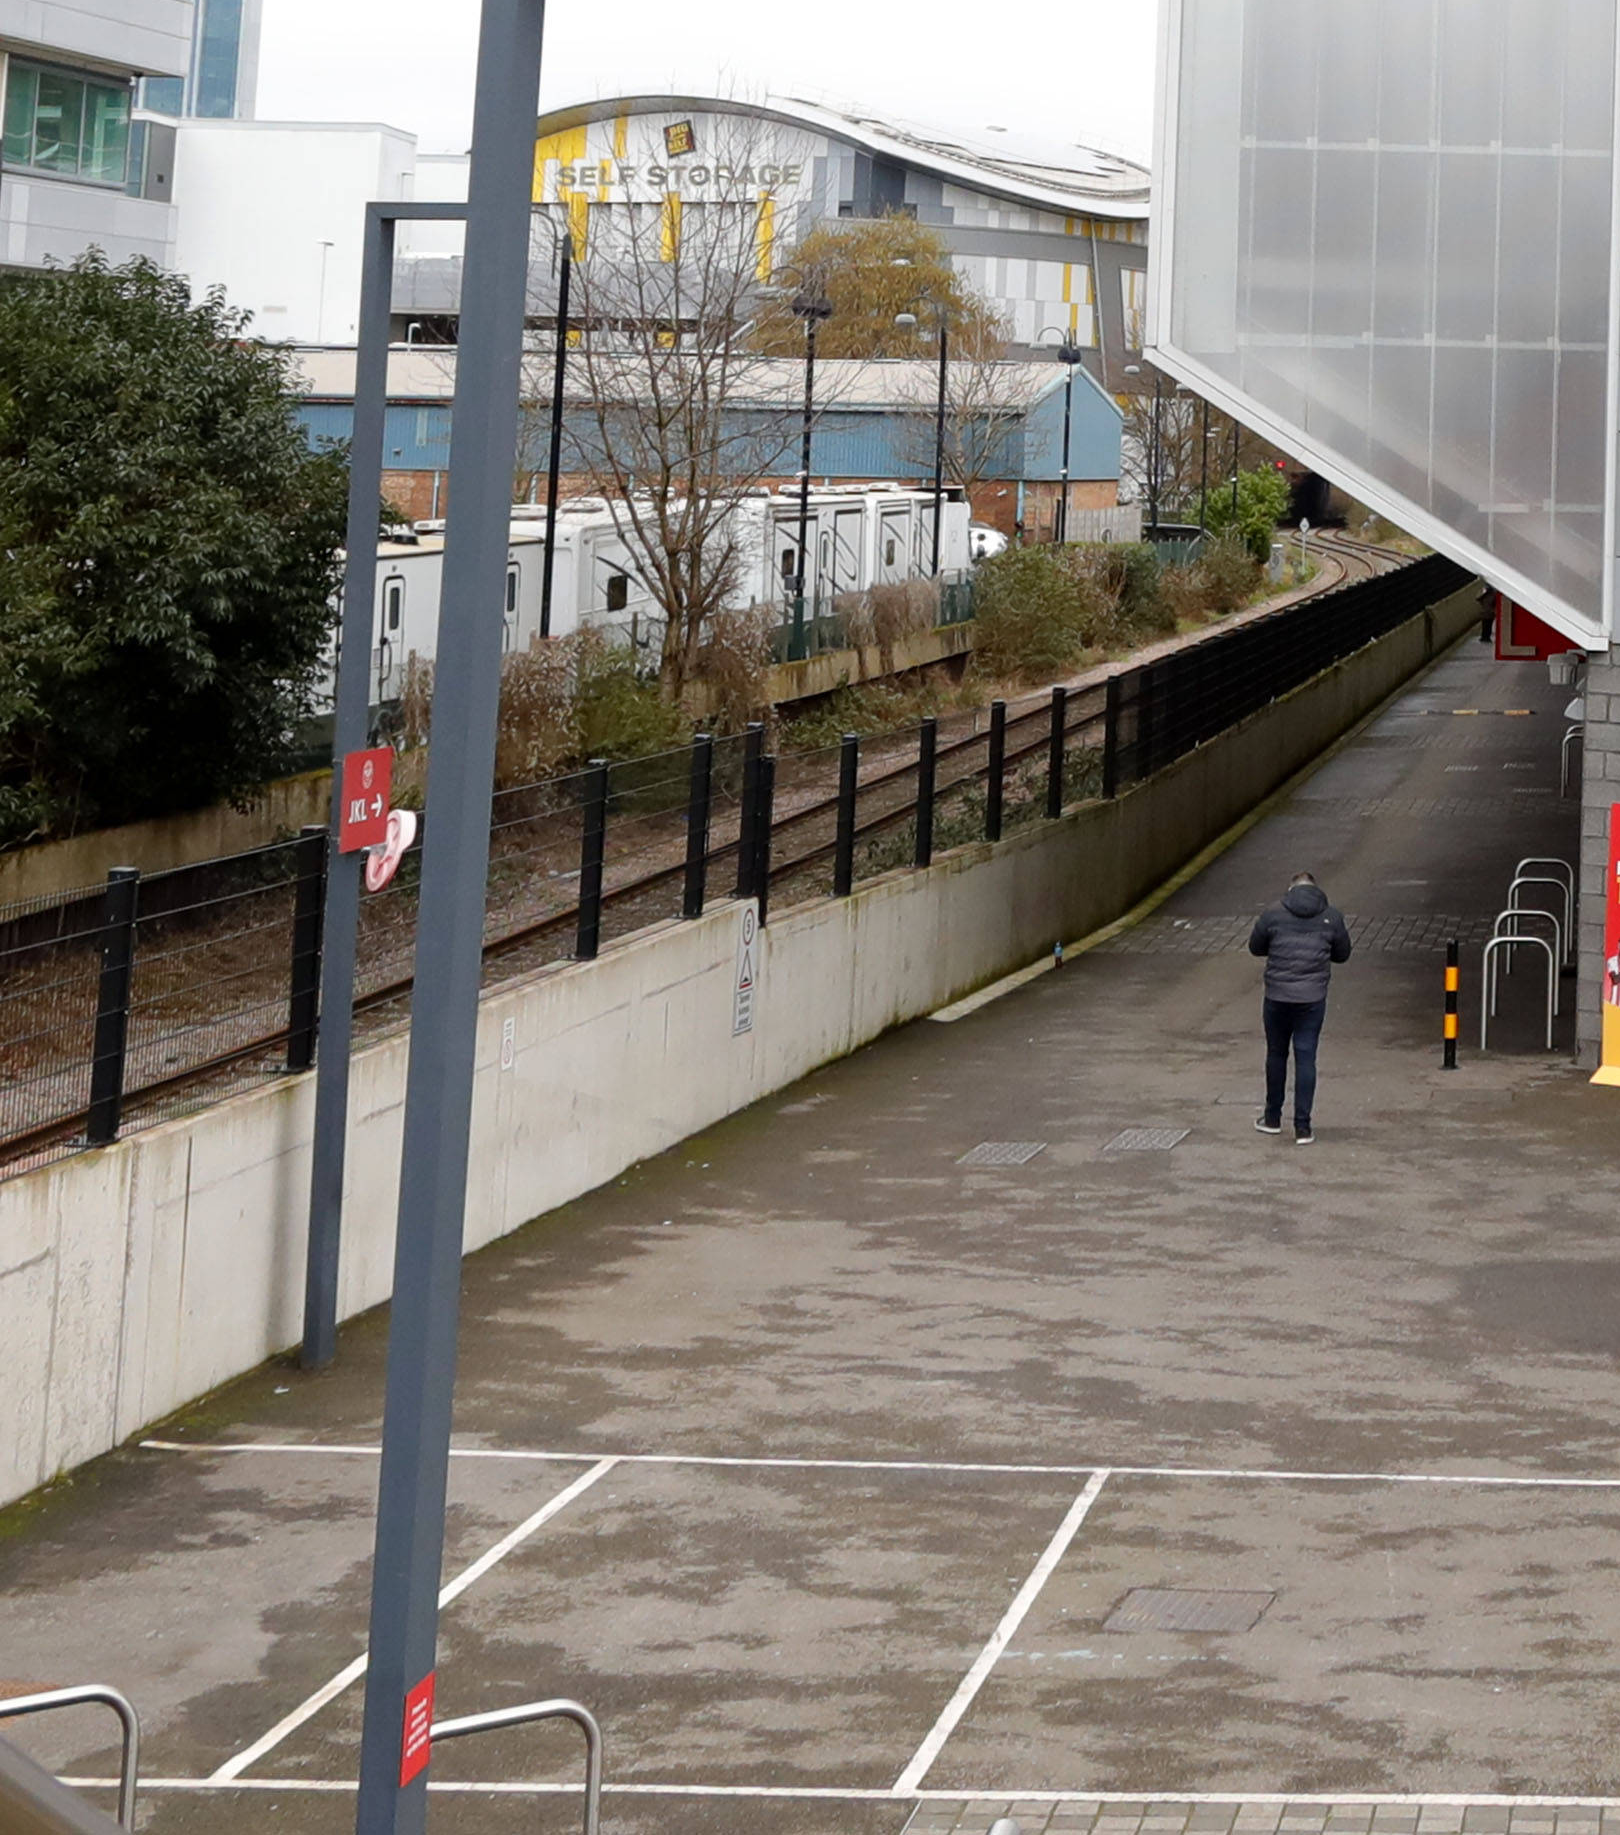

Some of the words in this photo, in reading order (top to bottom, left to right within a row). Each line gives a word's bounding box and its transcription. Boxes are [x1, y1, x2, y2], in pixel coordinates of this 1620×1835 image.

[557, 166, 635, 187] SELF
[647, 165, 801, 186] STORAGE
[348, 798, 368, 824] JKL
